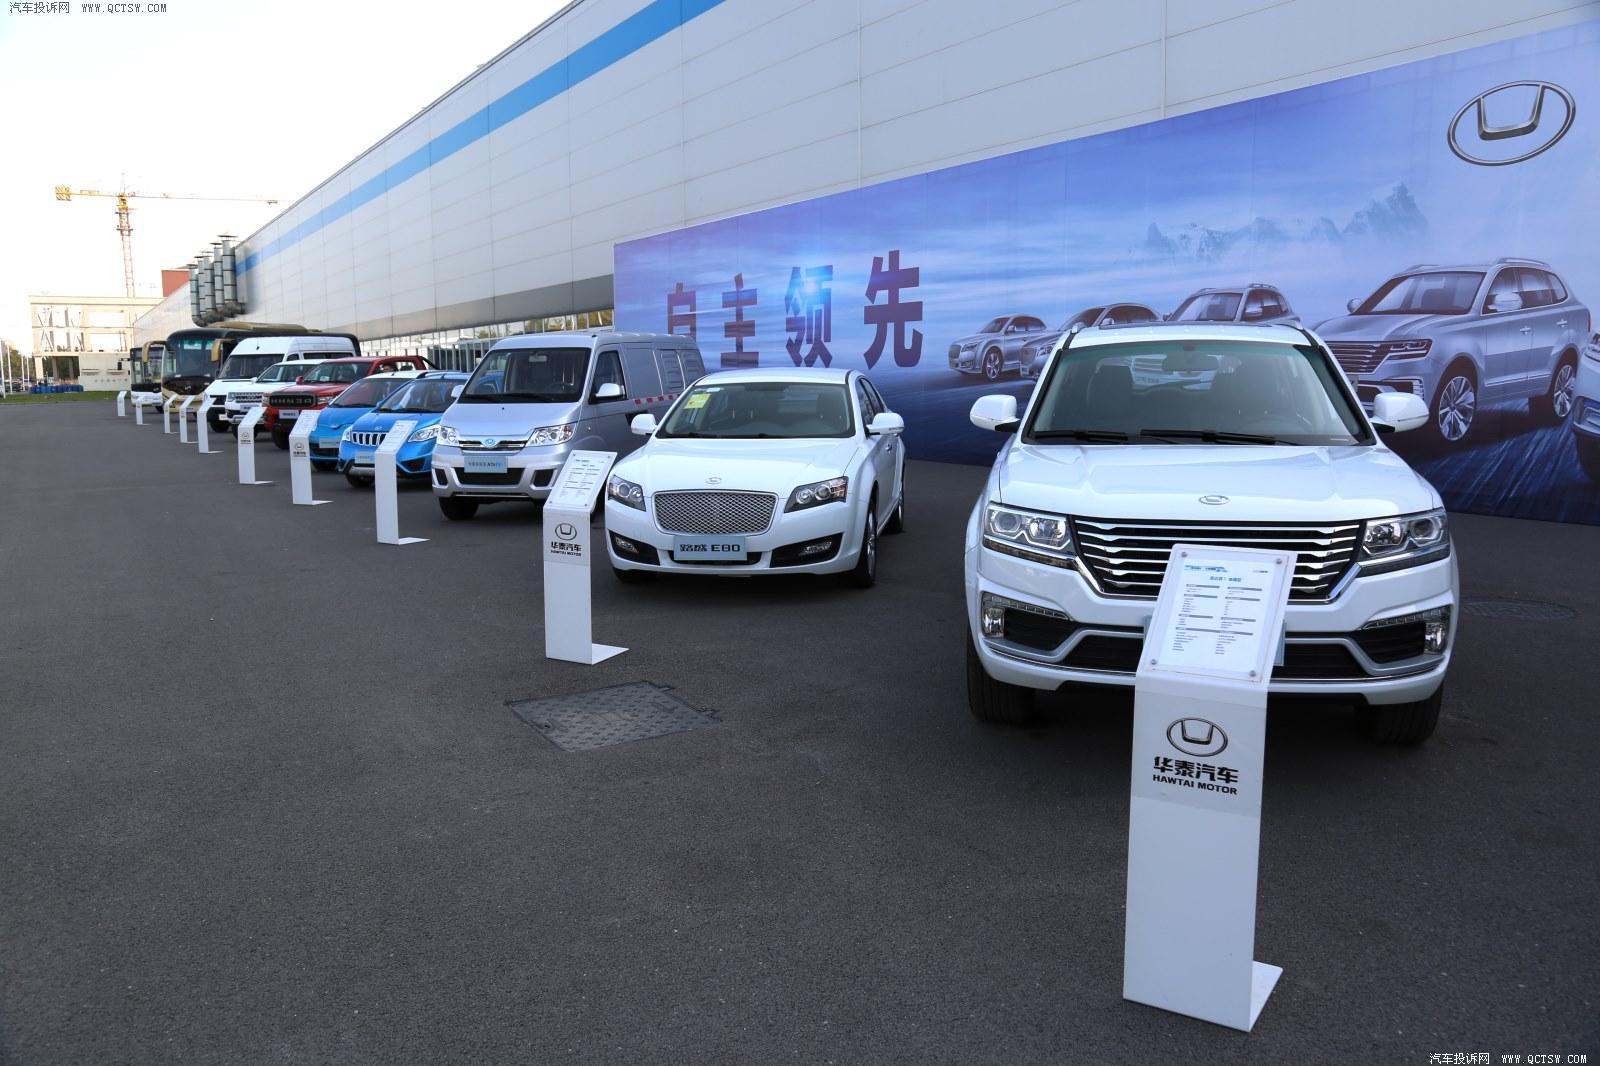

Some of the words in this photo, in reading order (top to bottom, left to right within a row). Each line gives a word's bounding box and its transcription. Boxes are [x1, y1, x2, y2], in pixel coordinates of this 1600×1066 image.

[667, 249, 923, 369] 自主领先
[711, 544, 740, 552] E80
[1153, 756, 1239, 784] 华泰汽车
[1152, 774, 1194, 788] HAWTAI
[1197, 781, 1237, 795] MOTOR
